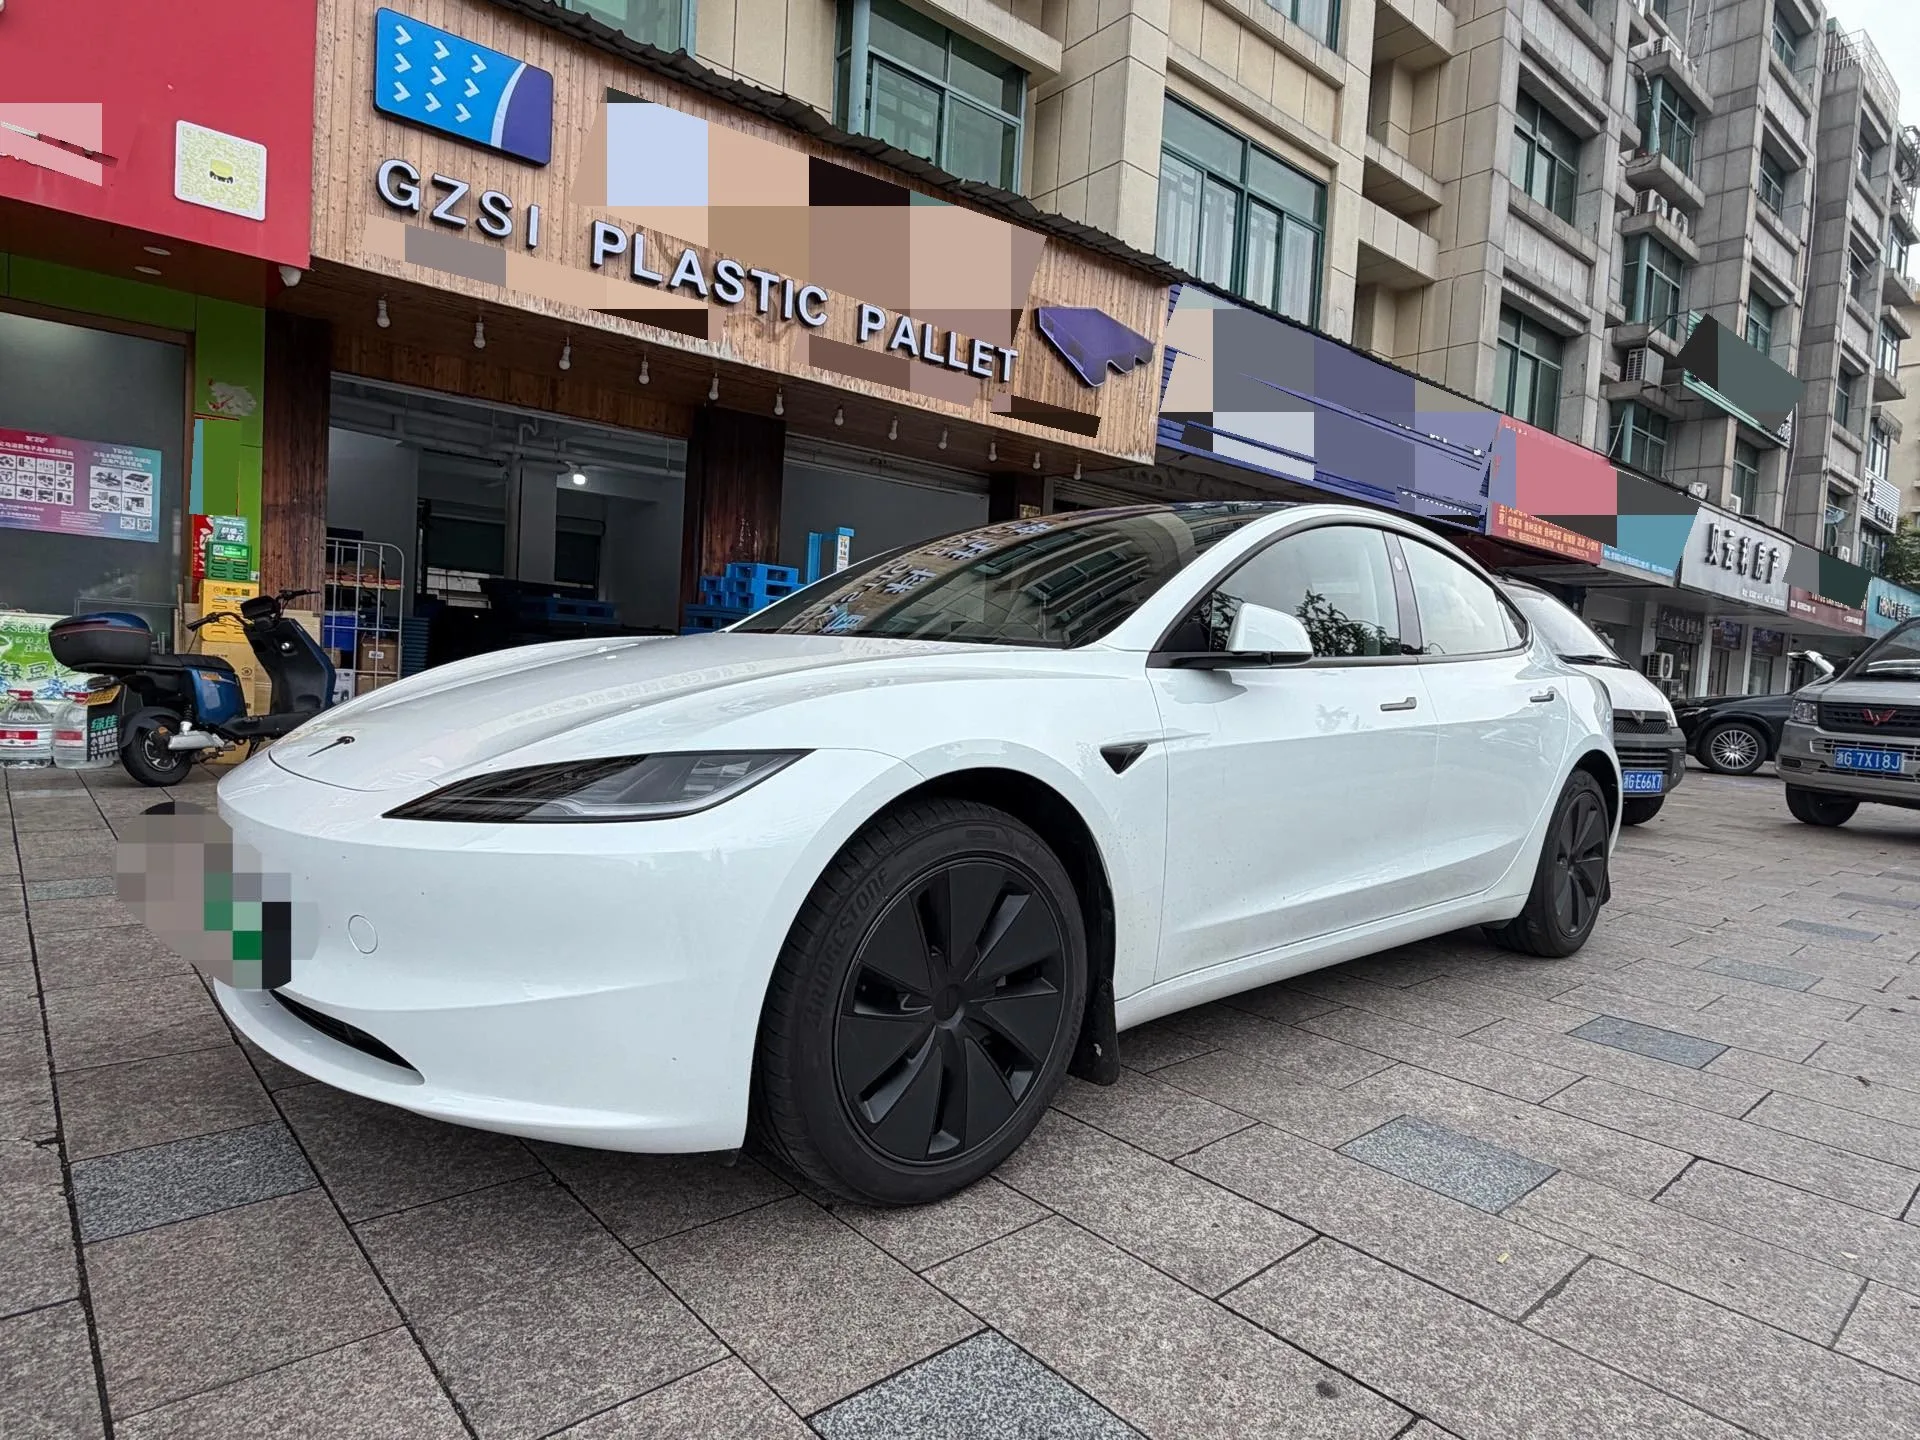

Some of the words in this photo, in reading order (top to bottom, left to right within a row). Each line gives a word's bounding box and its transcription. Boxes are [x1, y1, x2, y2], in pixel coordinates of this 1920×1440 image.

[376, 158, 541, 249] GZSI
[591, 219, 829, 328] PLASTIC
[858, 303, 1018, 383] PALLET
